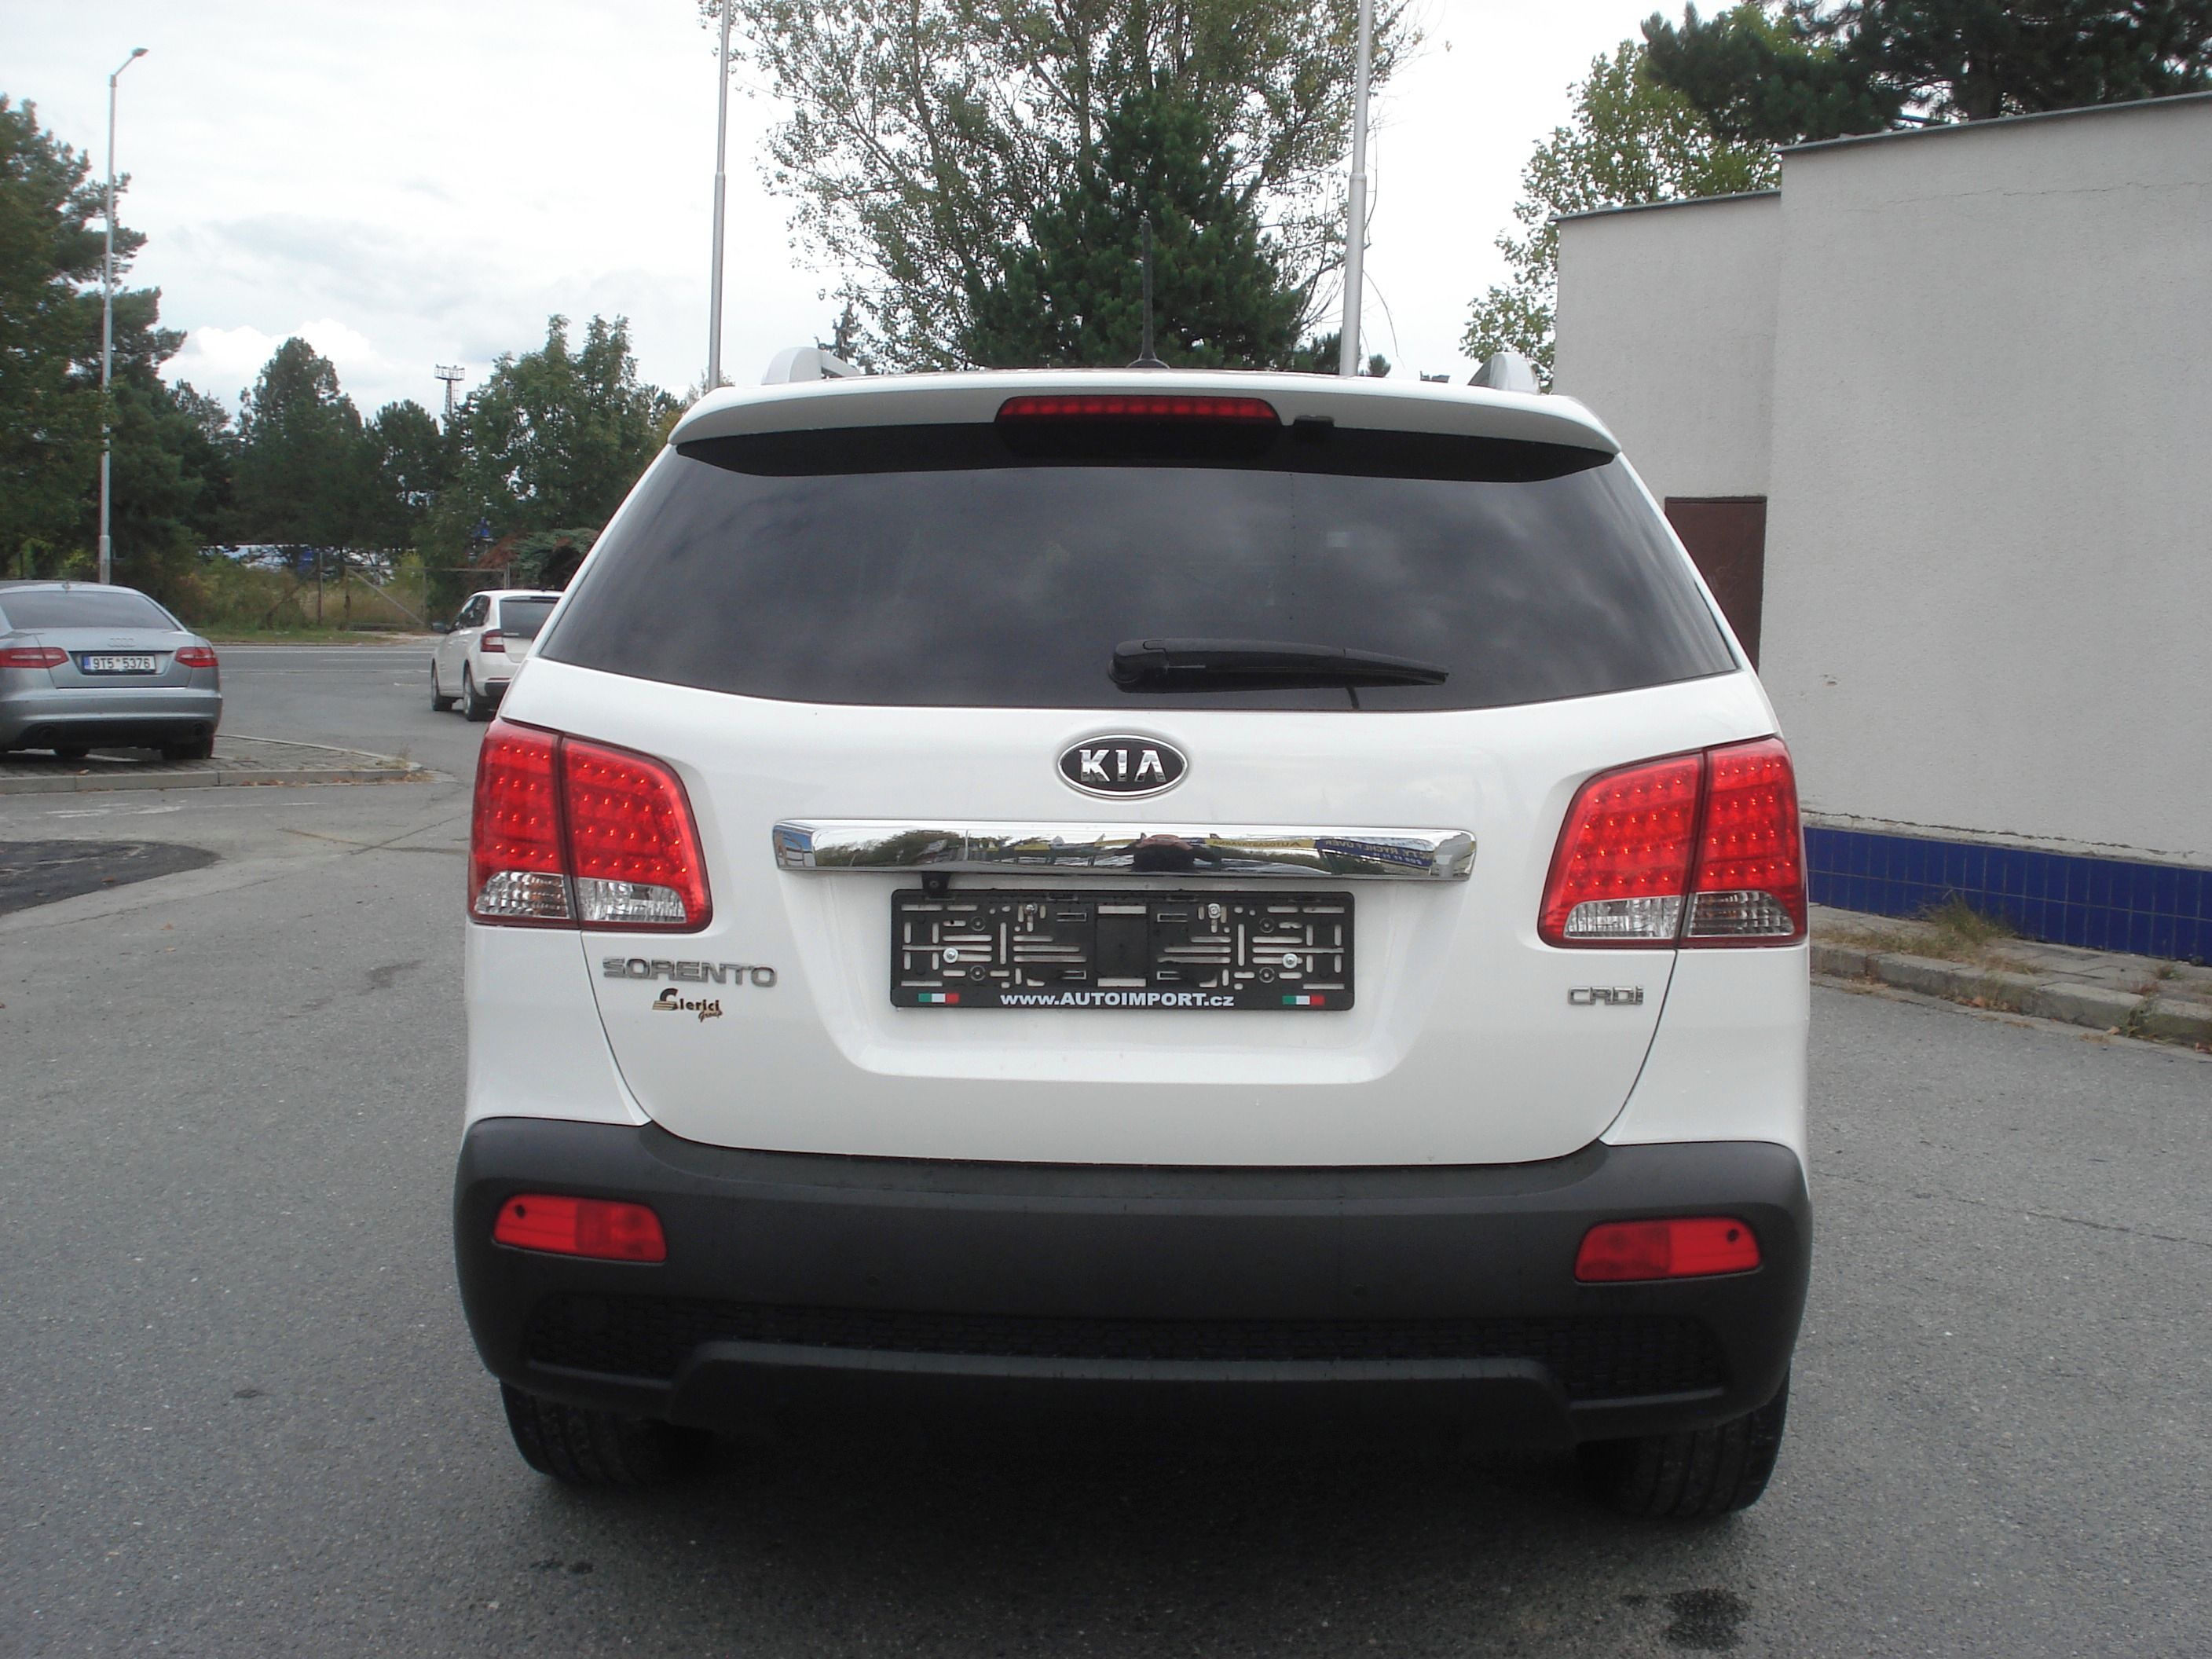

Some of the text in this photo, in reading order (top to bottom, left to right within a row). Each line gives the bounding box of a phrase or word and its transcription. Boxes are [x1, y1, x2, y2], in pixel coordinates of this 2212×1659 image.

[93, 657, 151, 669] 9T5 5376
[1079, 749, 1167, 782] KIA
[602, 958, 778, 988] SORENTO
[1000, 991, 1234, 1007] www.AUTOIMPORT.cz
